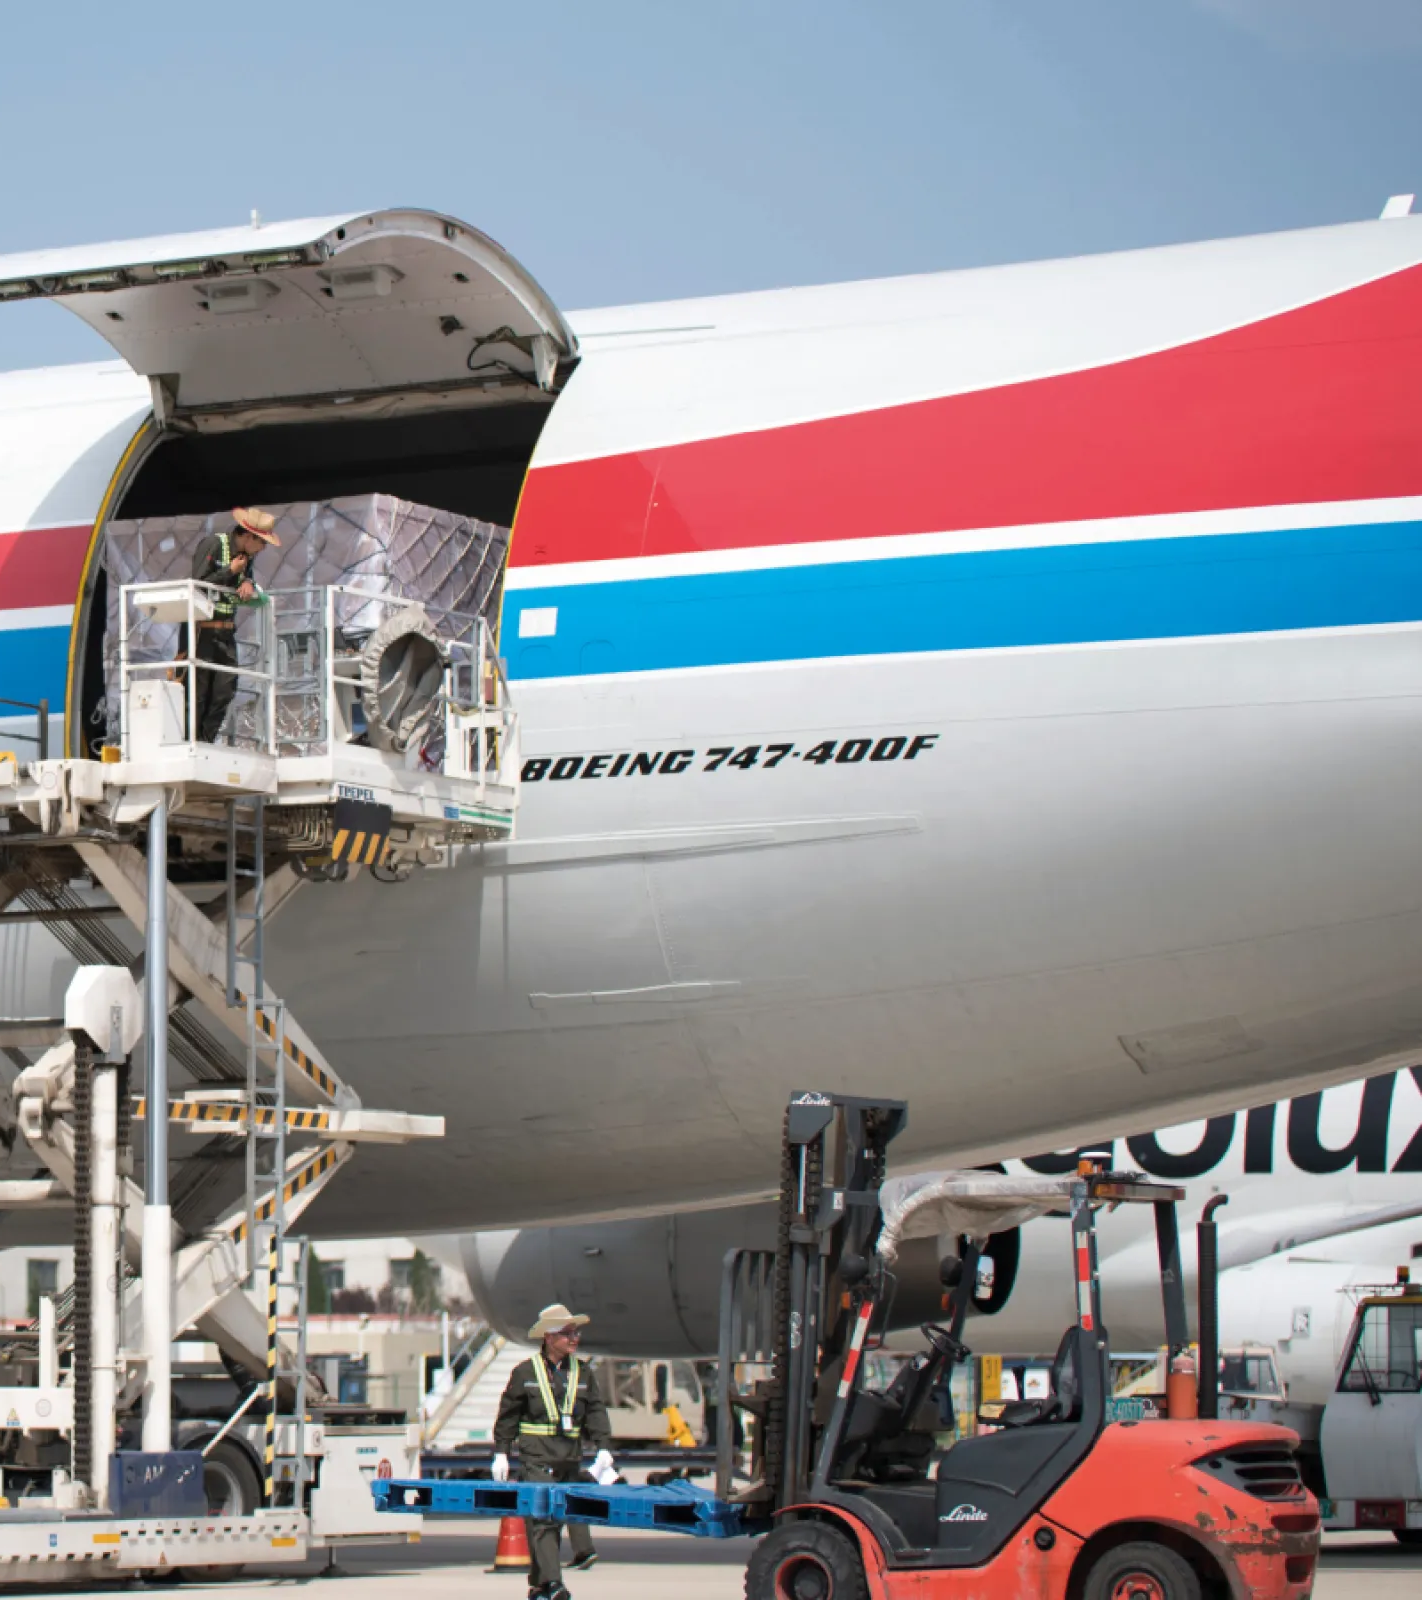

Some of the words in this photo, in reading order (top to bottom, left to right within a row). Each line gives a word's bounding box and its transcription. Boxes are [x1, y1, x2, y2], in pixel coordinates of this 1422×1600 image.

[520, 749, 695, 783] BOEING
[702, 733, 940, 772] 747-400F
[790, 1091, 831, 1106] Linde
[939, 1503, 989, 1522] Linde
